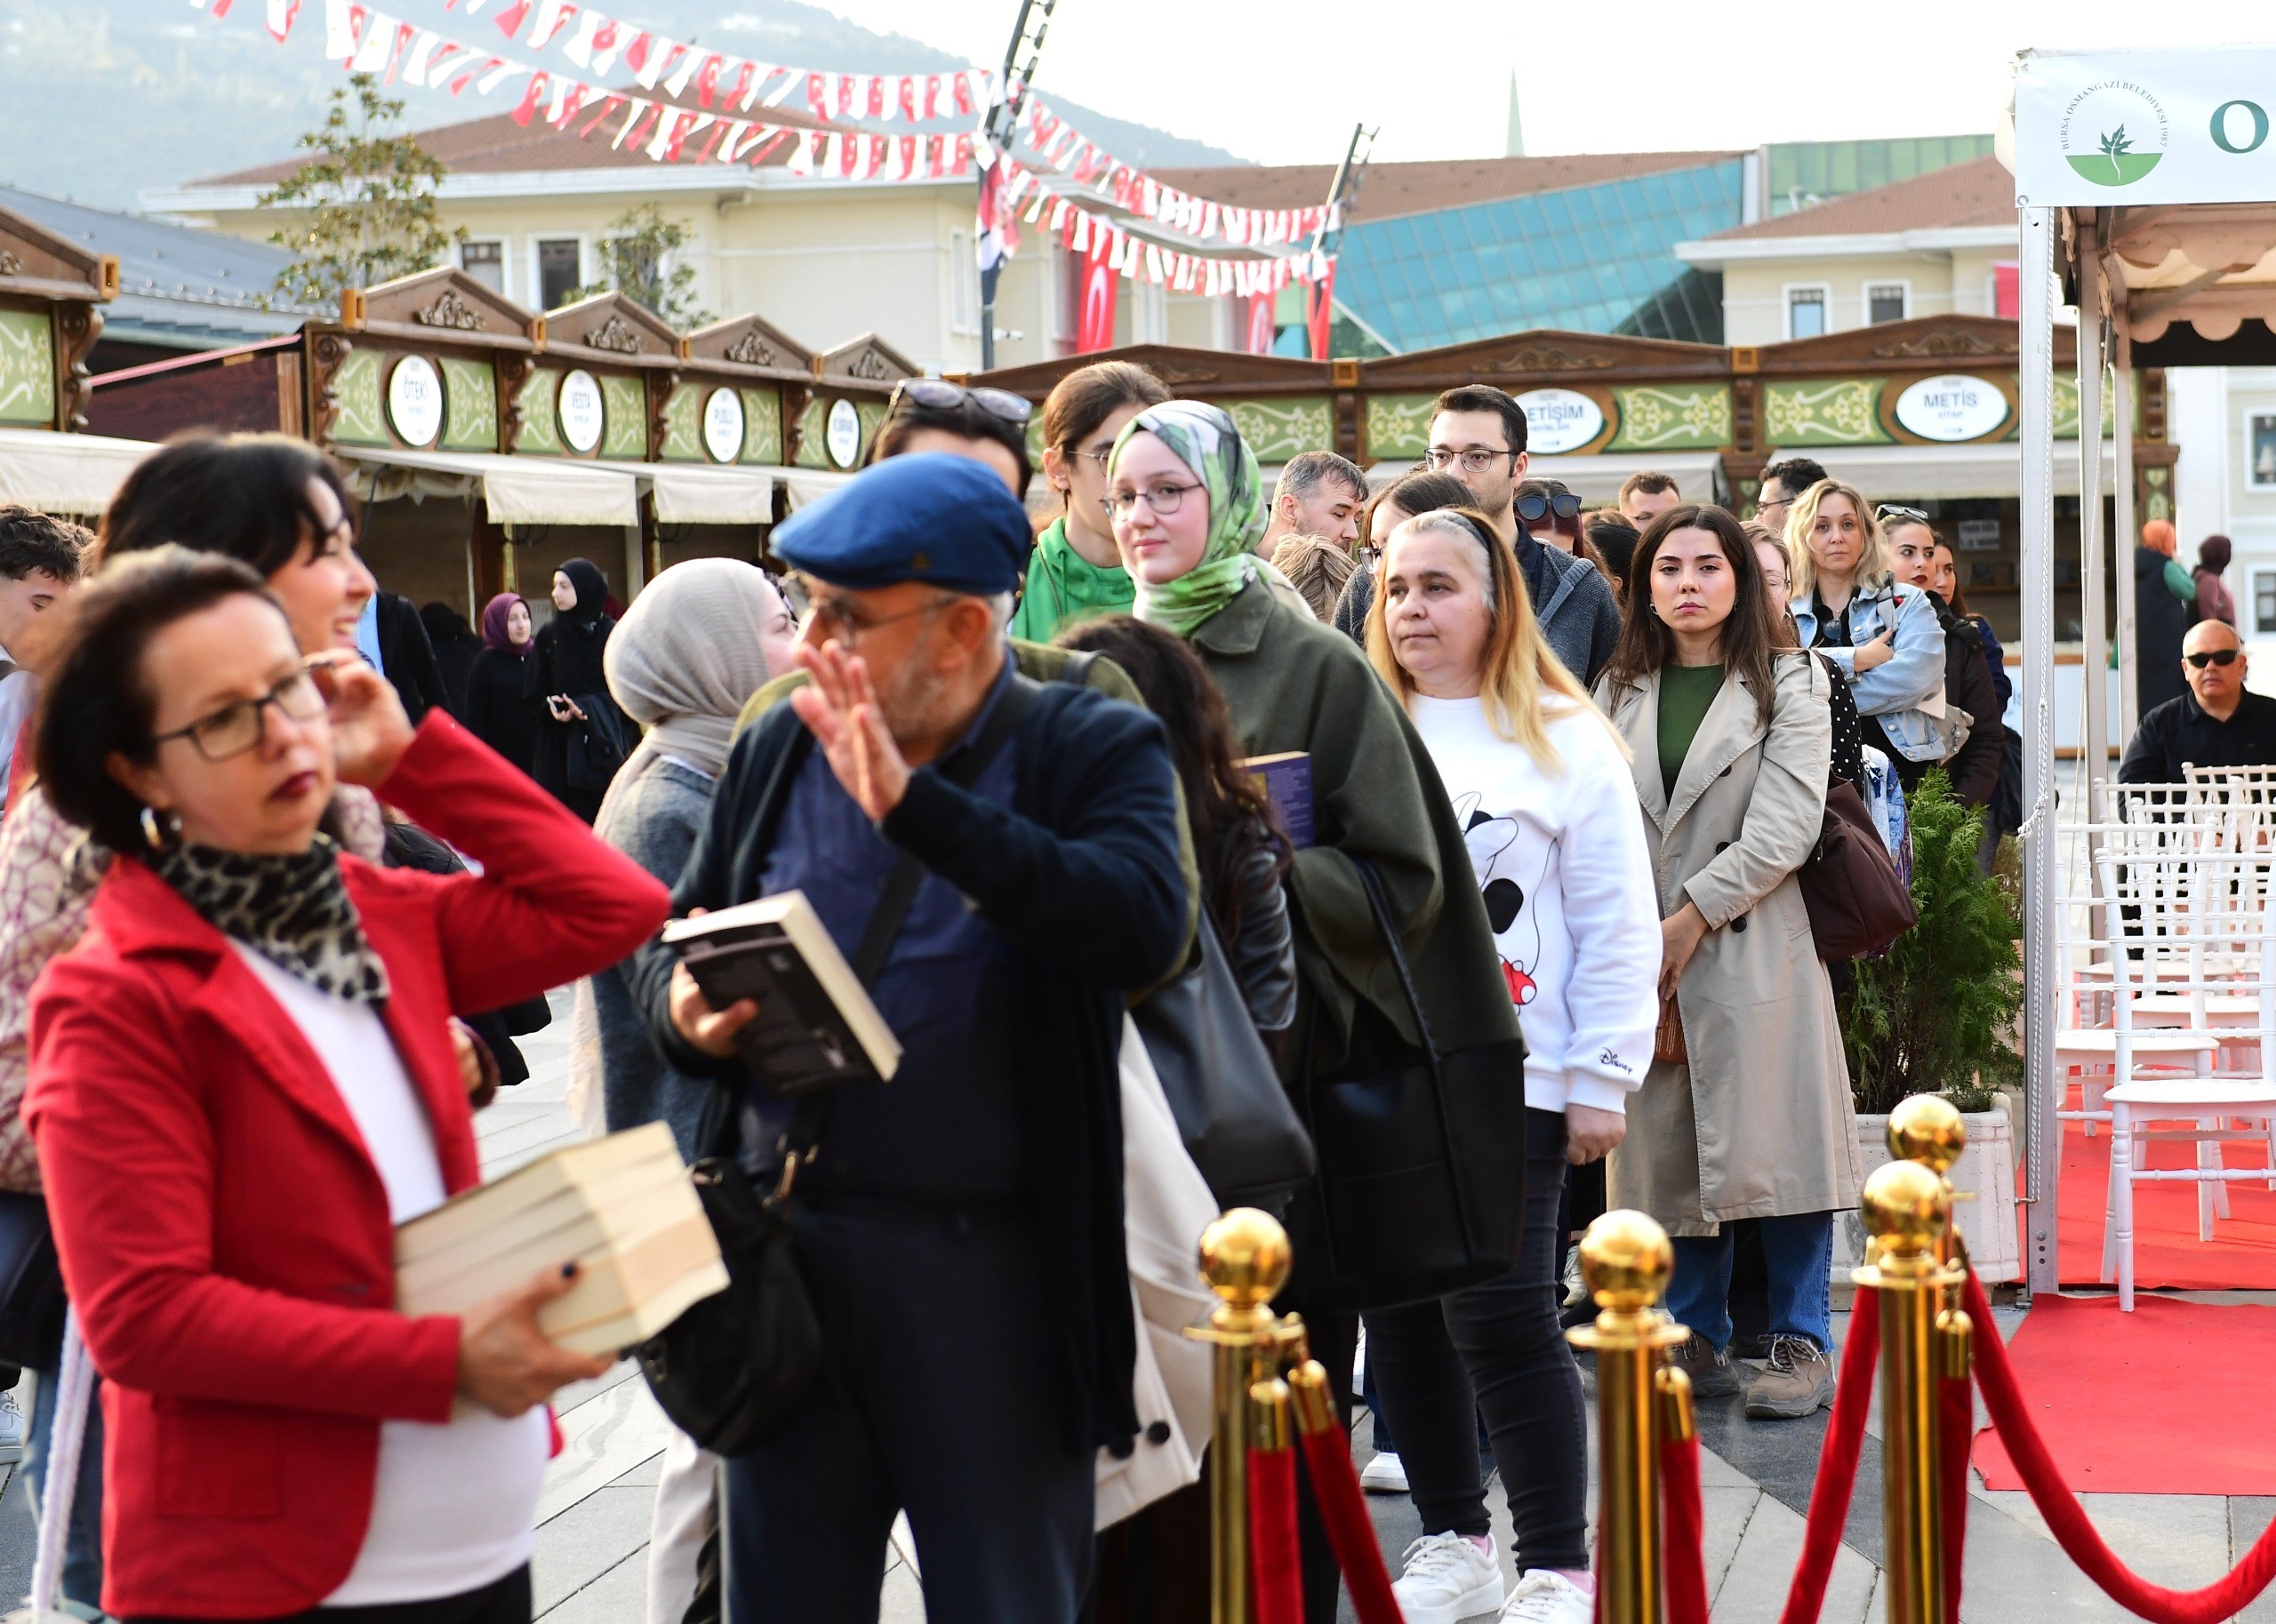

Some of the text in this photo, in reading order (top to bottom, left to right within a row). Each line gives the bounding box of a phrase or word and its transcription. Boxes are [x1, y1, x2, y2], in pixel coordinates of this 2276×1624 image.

[2060, 79, 2169, 150] BURSA OSMANGAZİ BELEDİYESİ 1987
[1923, 388, 1978, 409] METİS
